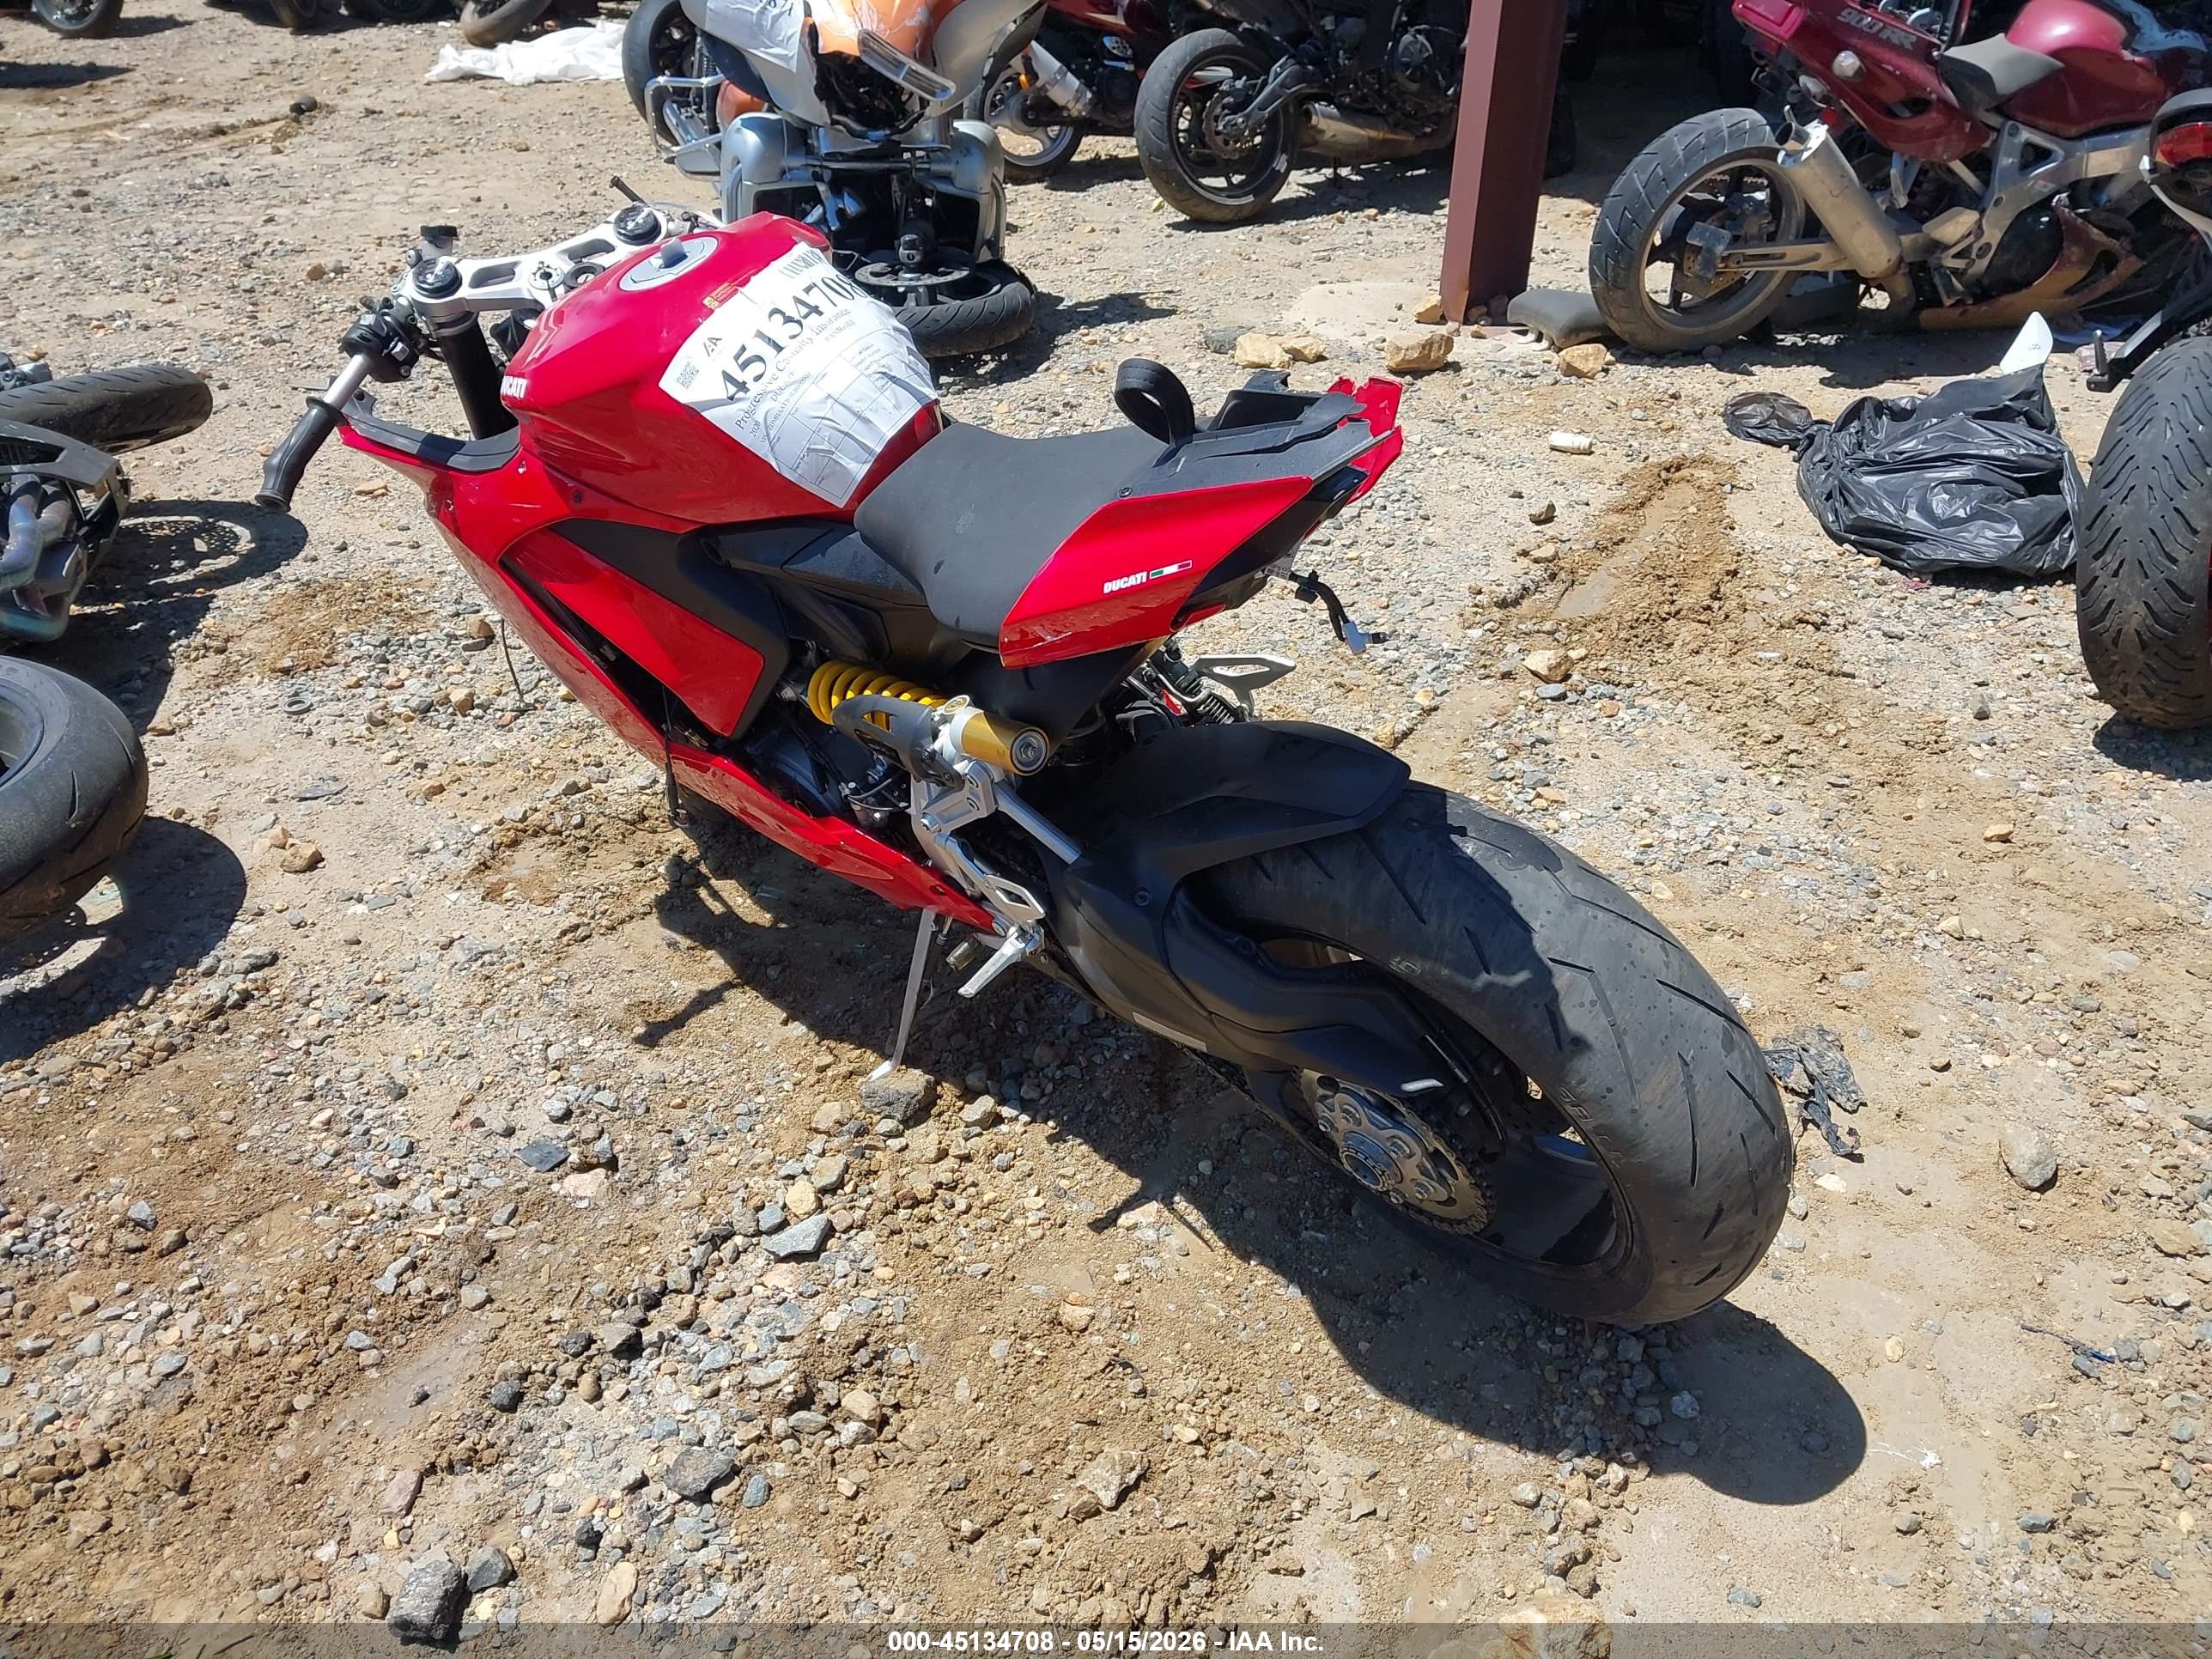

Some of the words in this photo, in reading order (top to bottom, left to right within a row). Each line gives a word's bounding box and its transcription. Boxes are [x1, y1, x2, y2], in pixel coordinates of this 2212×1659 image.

[721, 274, 867, 401] 45134708
[735, 373, 778, 430] Progressive
[811, 309, 852, 336] Insurance
[750, 420, 761, 439] 2020
[1103, 571, 1147, 594] DUCATI
